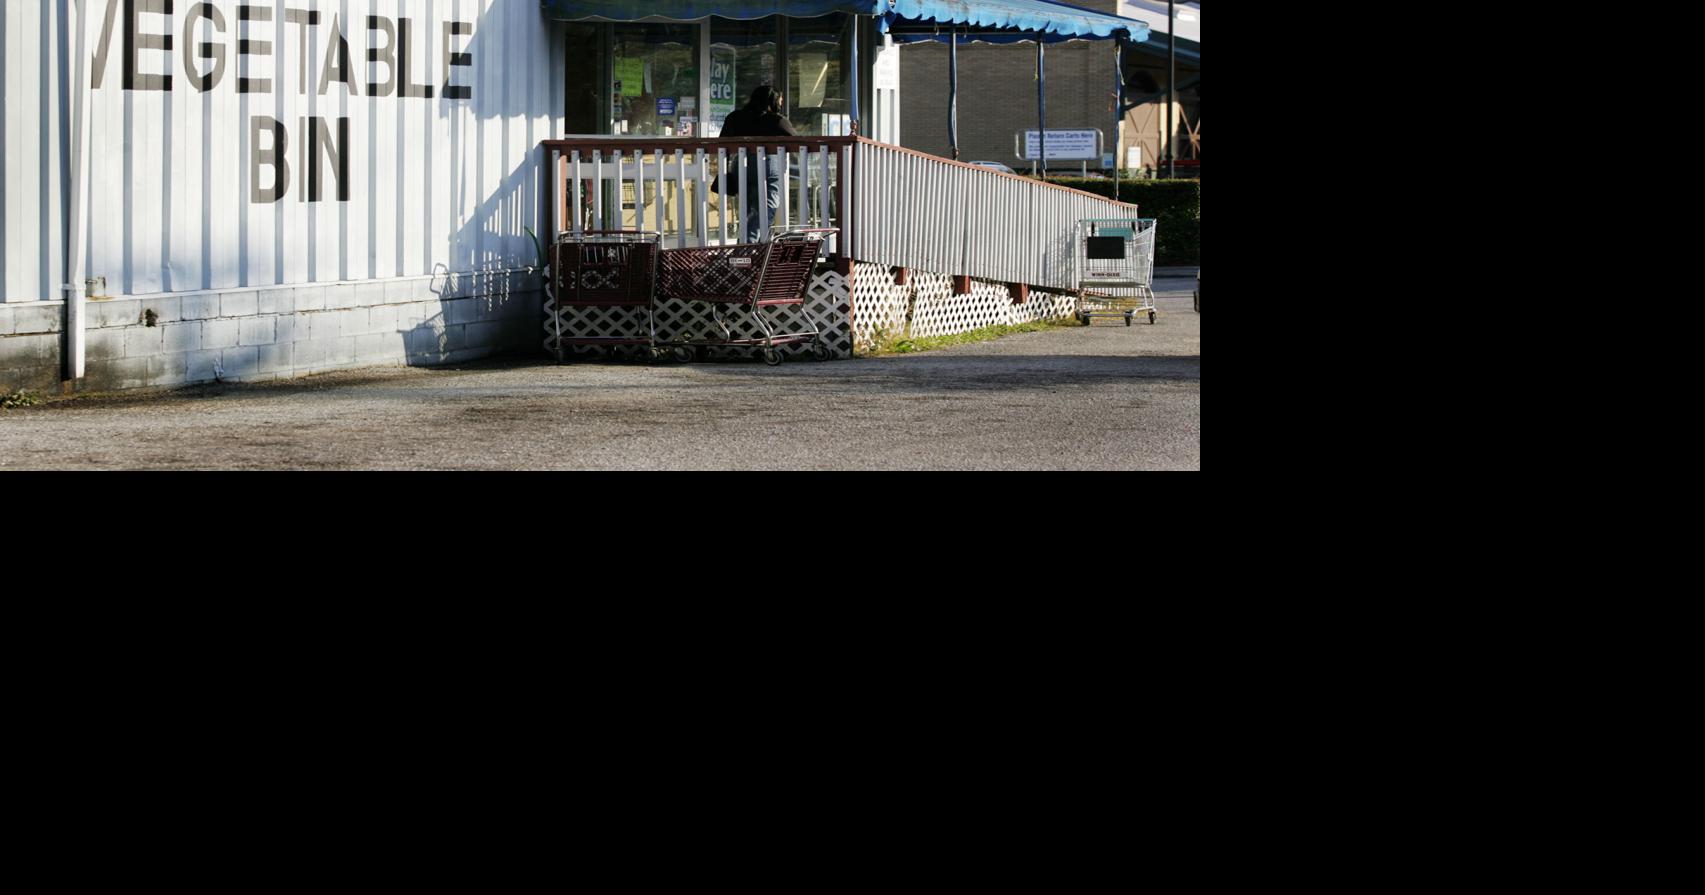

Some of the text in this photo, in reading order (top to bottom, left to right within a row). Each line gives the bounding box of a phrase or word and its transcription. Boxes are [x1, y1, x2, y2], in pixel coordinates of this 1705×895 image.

[711, 57, 729, 83] lay
[710, 82, 731, 99] ere
[250, 115, 350, 203] BIN
